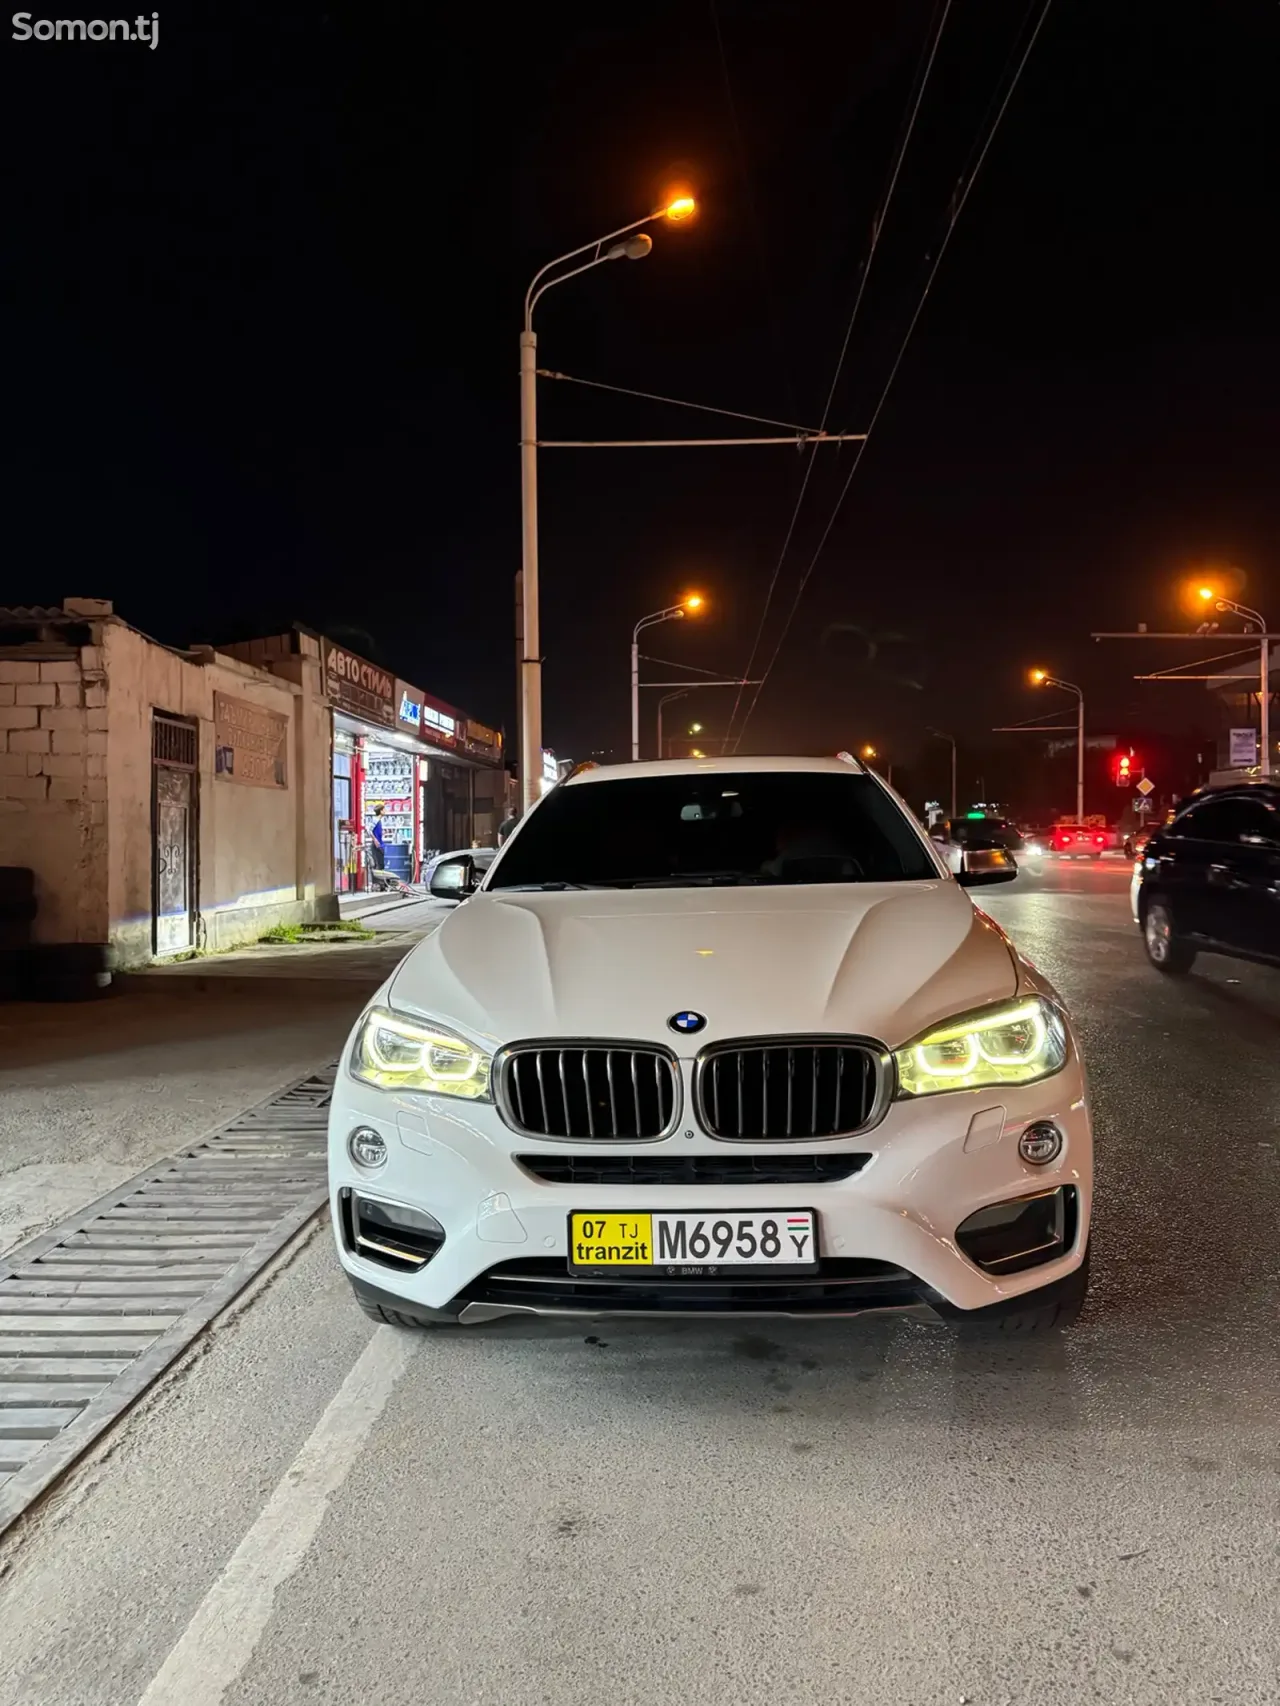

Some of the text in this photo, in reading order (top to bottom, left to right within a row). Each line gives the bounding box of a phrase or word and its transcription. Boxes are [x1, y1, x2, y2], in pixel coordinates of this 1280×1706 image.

[582, 1220, 639, 1239] 07 TJ
[658, 1219, 810, 1260] M6958 Y
[576, 1241, 649, 1261] tranzit
[681, 1266, 704, 1275] BMW
